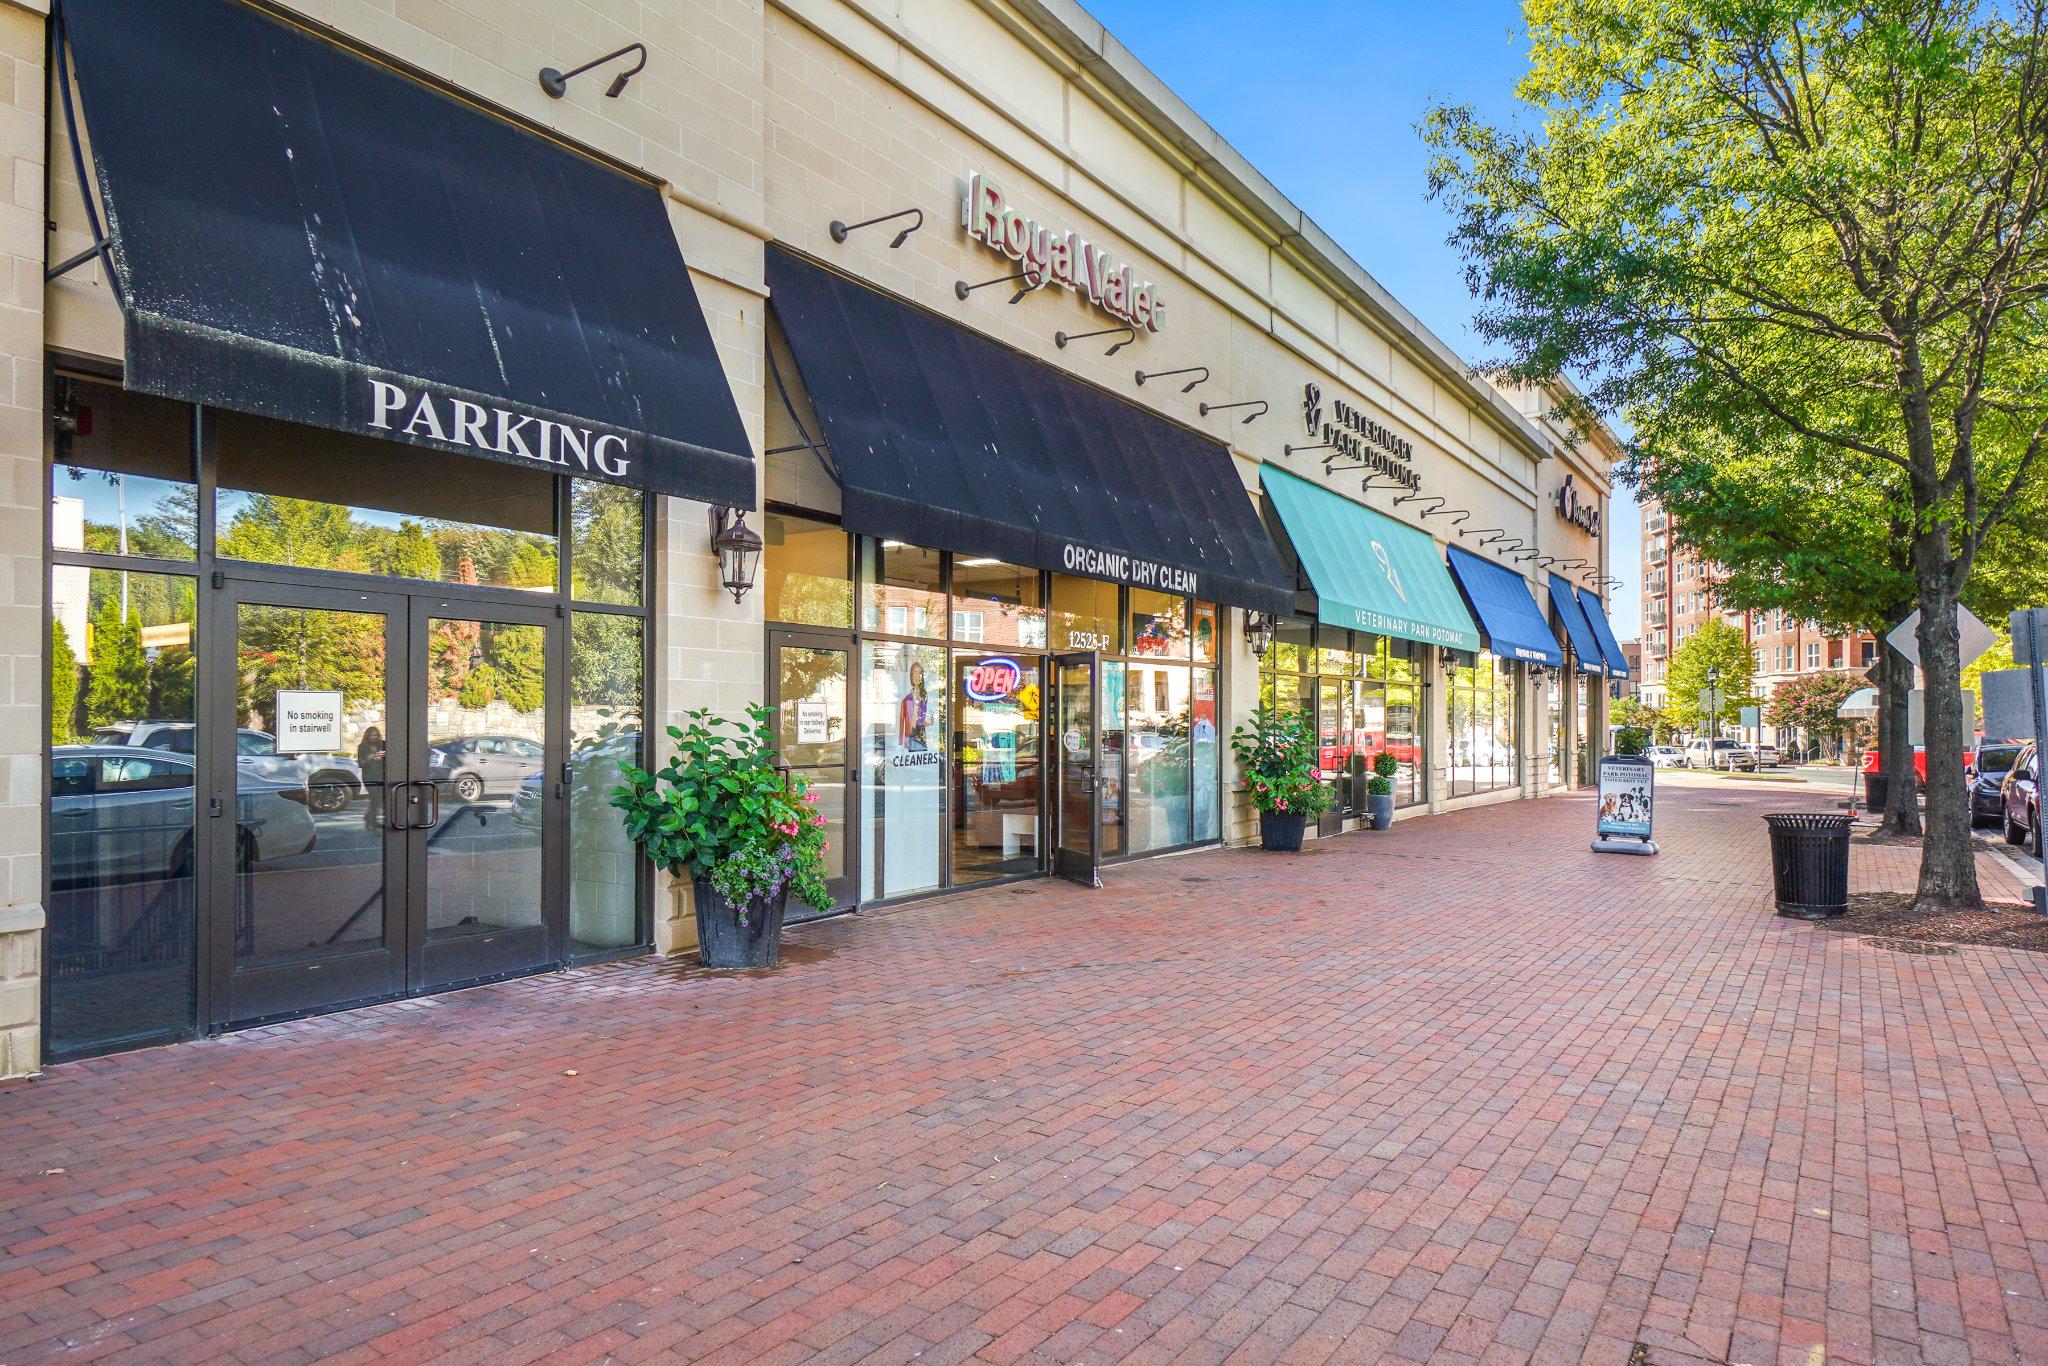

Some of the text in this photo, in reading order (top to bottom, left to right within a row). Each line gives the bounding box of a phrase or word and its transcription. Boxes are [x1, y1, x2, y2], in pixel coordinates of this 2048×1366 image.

[968, 169, 1167, 333] Royal Valet
[367, 379, 631, 477] PARKING
[1334, 400, 1413, 462] VETERINARY
[1322, 423, 1421, 492] PARK POTOMAC
[1063, 543, 1198, 594] ORGANIC DRY CLEAN
[1068, 631, 1110, 651] 12525-F
[1354, 607, 1463, 645] VETERINARY PARK POTOMAC
[970, 667, 1017, 694] OPEN
[287, 710, 334, 722] No smoking
[290, 723, 331, 733] in stairwell
[893, 752, 939, 768] CLEANERS
